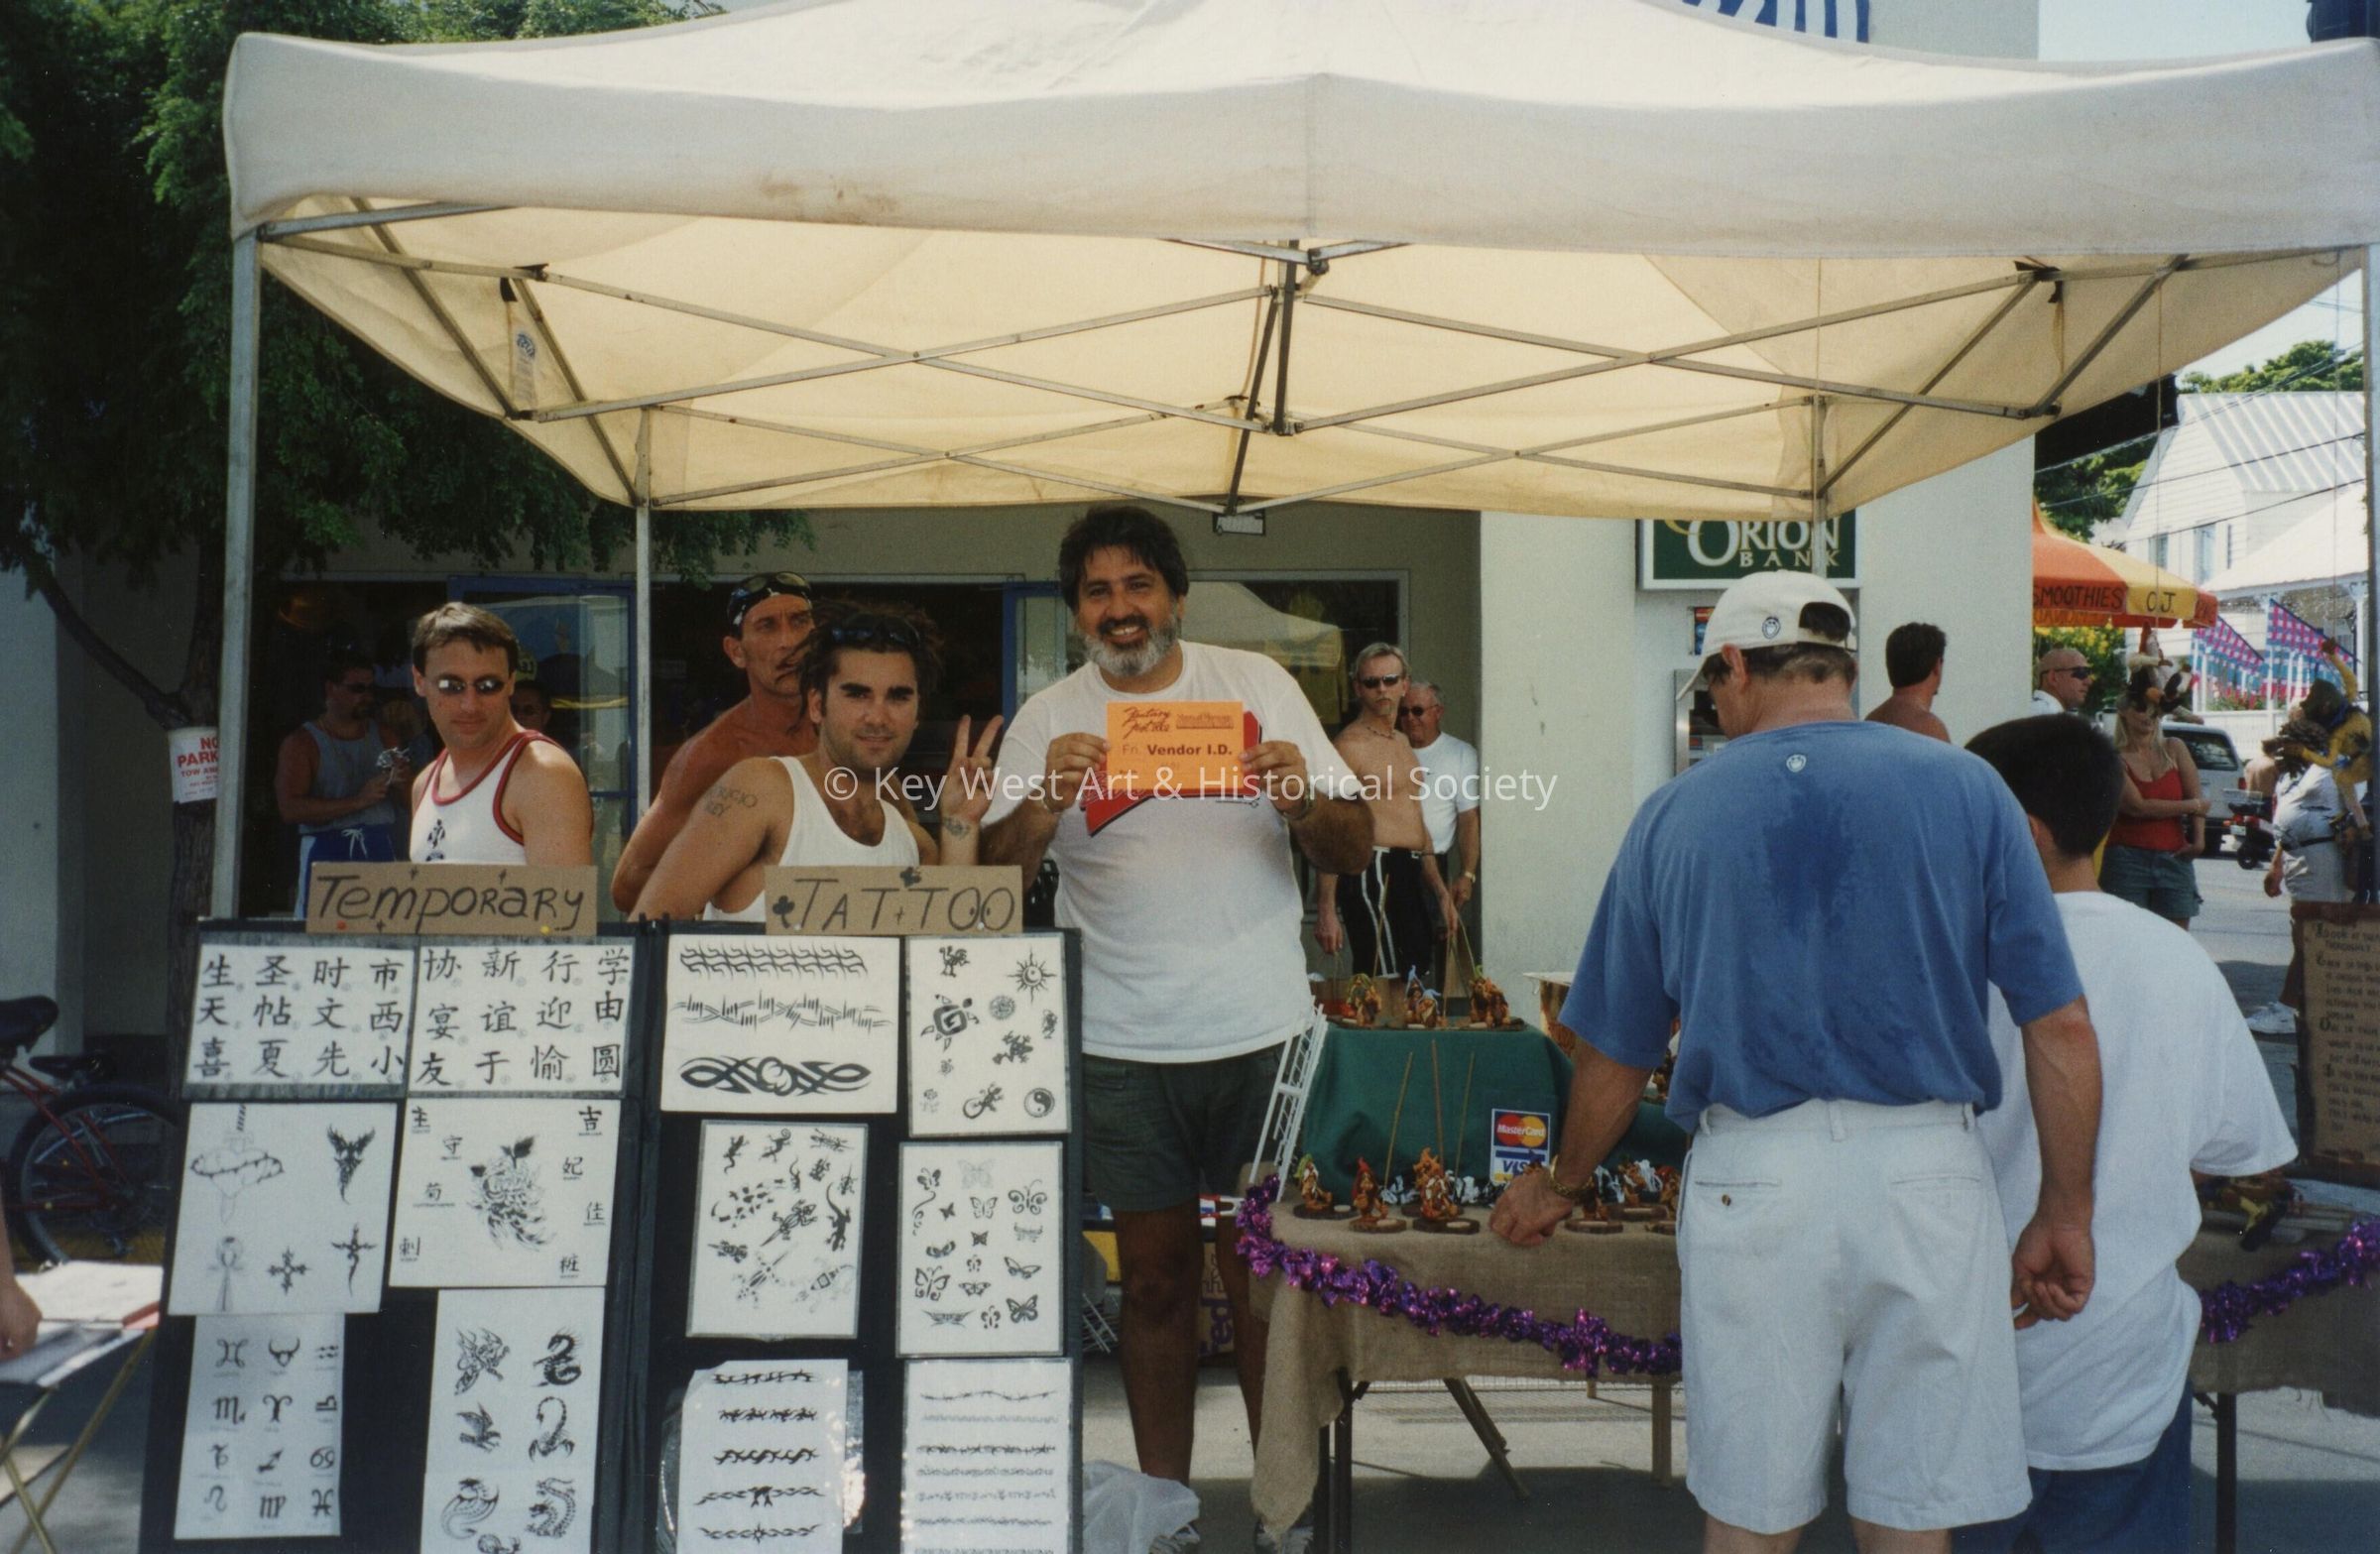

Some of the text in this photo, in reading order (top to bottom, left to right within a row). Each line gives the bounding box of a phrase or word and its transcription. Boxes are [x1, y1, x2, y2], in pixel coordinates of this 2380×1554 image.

[1687, 517, 1840, 567] ORION
[1739, 551, 1840, 567] BANK
[177, 751, 219, 768] PARK
[1146, 744, 1232, 756] Vendor I.D.
[794, 879, 1014, 930] TATTOO
[202, 953, 404, 990] 生 圣 时 市
[423, 948, 629, 985] 协 新 行 学
[198, 995, 405, 1032] 天 帖 文 西
[426, 991, 624, 1039] 宴 谊 迎 由
[193, 1037, 404, 1077] 喜 夏 先 小
[416, 1052, 452, 1086] 友
[475, 1051, 510, 1084] 于
[531, 1044, 570, 1081] 愉
[578, 1106, 602, 1131] 吉
[1503, 1160, 1528, 1176] VIS
